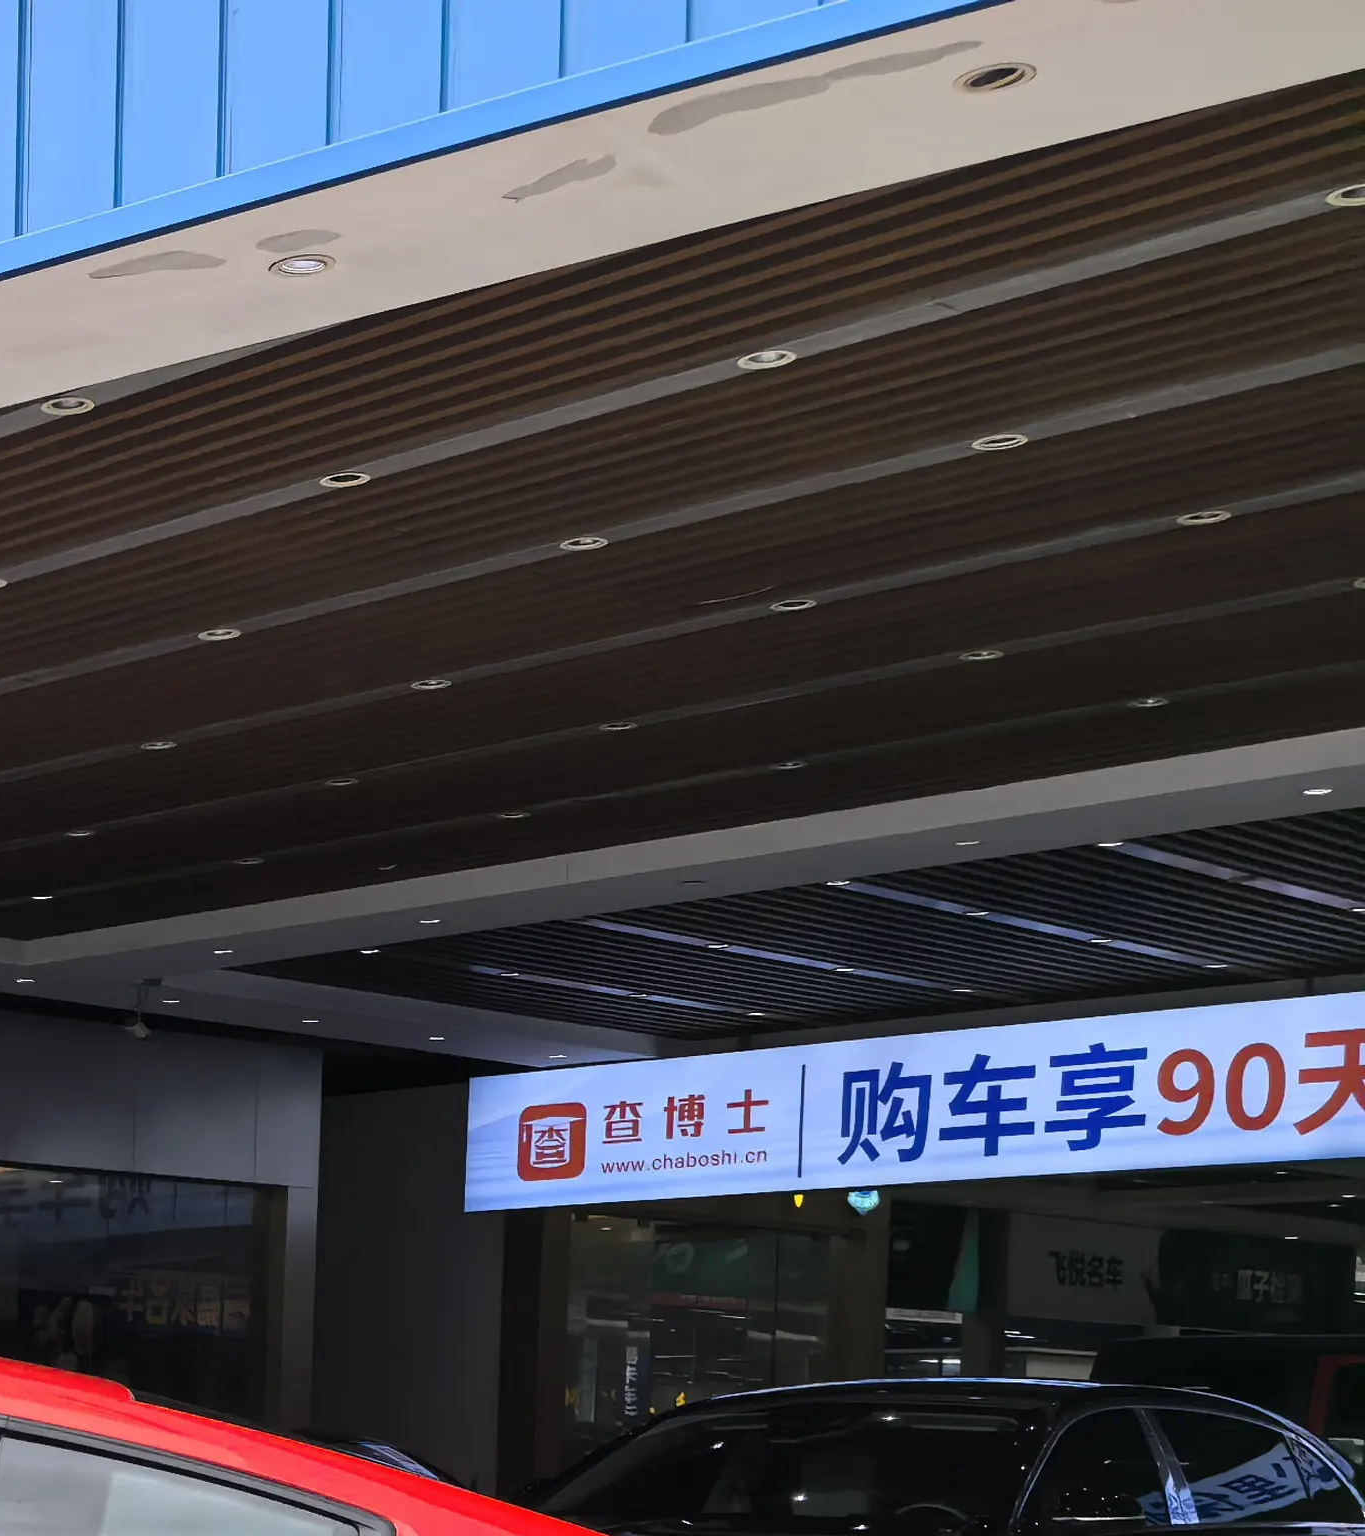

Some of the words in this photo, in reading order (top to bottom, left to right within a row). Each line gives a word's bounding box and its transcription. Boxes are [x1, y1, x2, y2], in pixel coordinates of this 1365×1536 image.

[601, 1089, 770, 1146] 查博士
[837, 1028, 1365, 1166] 购车享90天
[600, 1147, 769, 1175] www.chaboshi.cn
